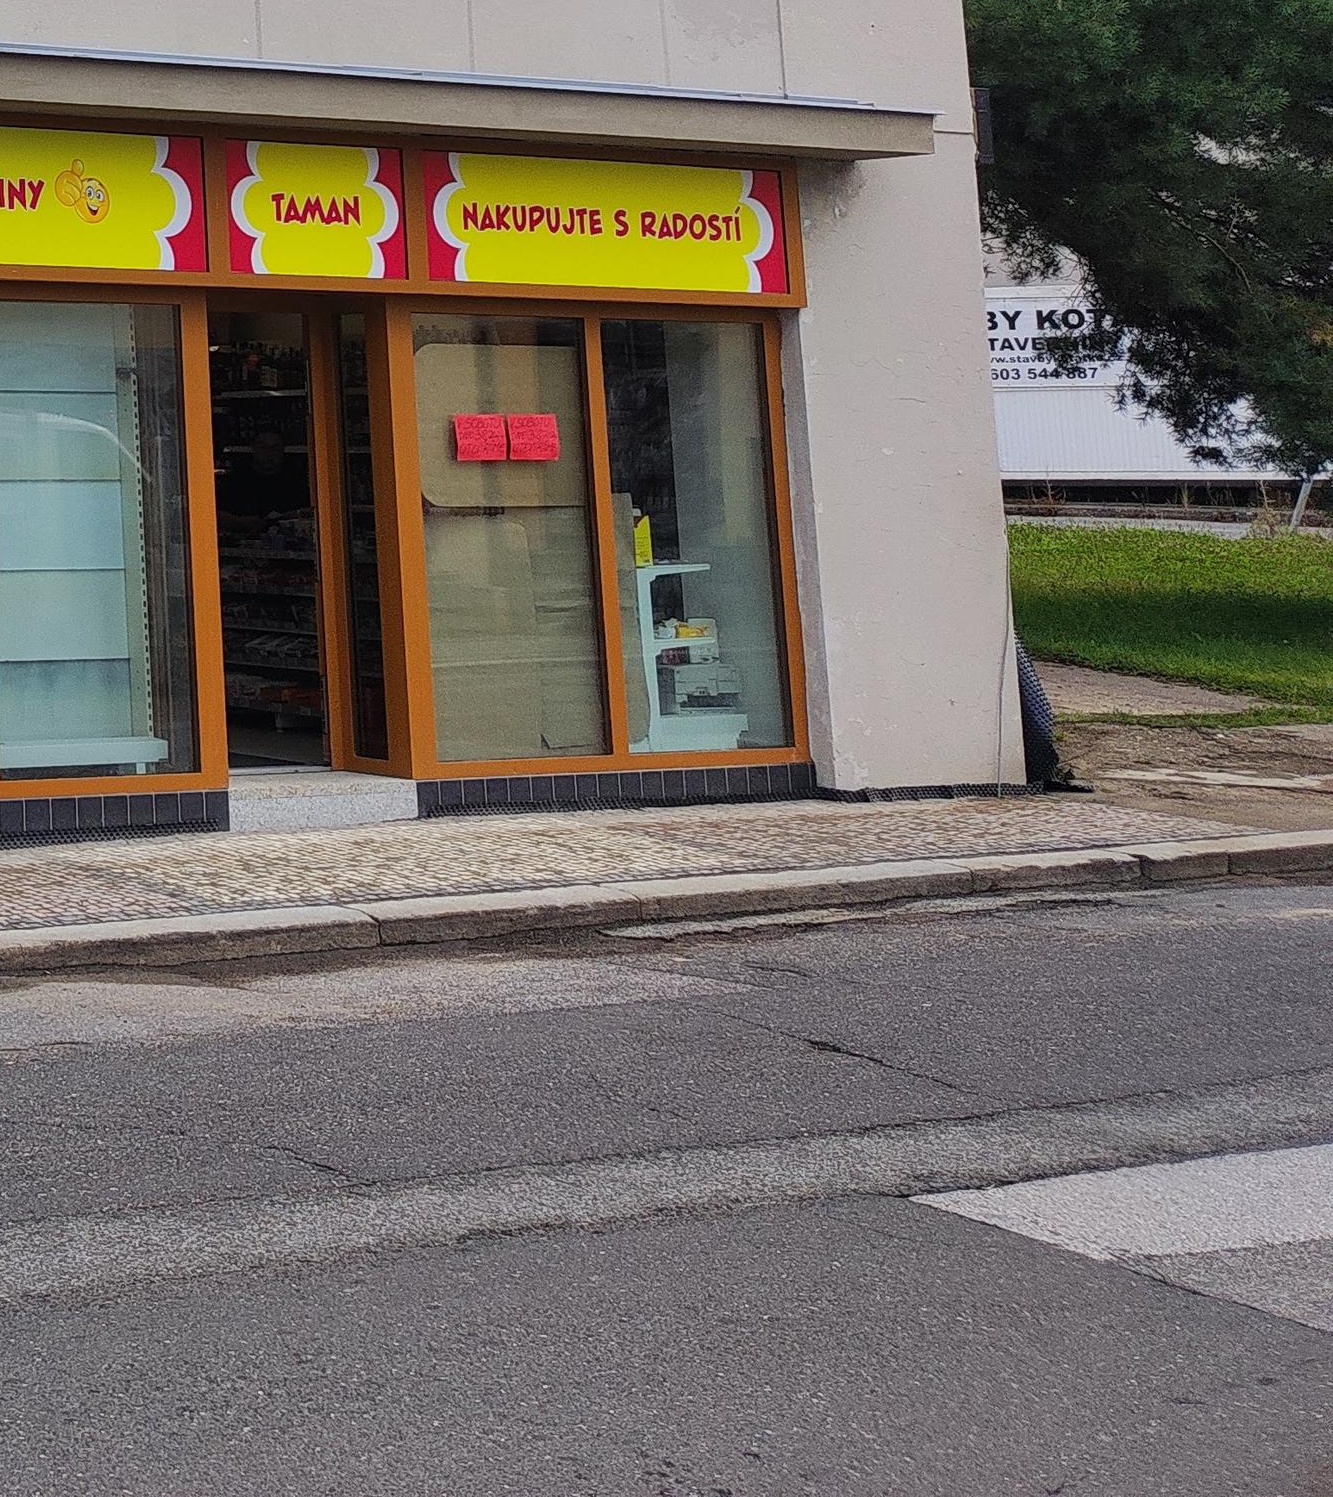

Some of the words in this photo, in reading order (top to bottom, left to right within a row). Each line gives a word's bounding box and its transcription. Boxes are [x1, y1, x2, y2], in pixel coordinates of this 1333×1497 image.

[271, 193, 361, 226] TAMAN
[462, 202, 603, 235] NAKUPUJTE
[614, 209, 629, 237] S
[640, 206, 742, 241] RADOSTÍ
